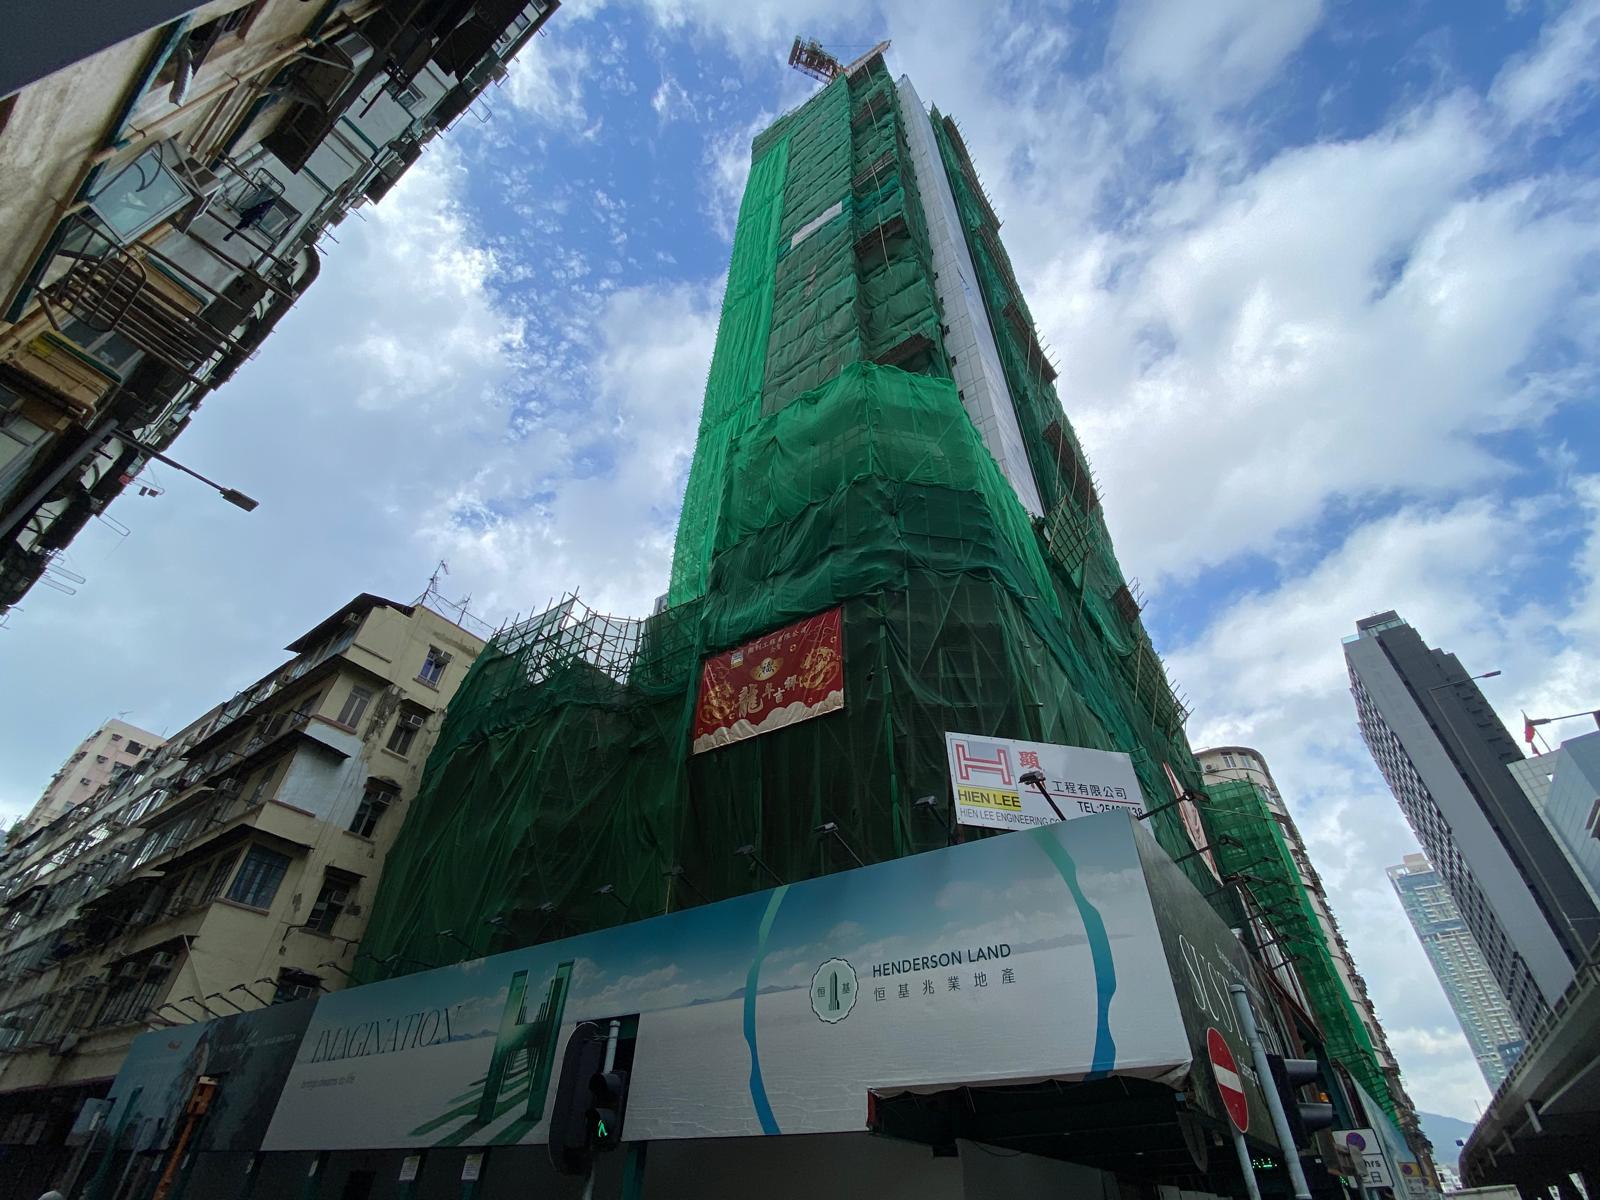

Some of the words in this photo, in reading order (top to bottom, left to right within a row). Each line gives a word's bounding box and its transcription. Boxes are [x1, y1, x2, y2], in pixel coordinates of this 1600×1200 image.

[735, 675, 797, 718] 龍年吉祥
[958, 789, 990, 804] HIEN
[992, 794, 1022, 808] LEE
[1052, 780, 1127, 800] 工程有限公司
[960, 807, 979, 818] HIEN
[980, 811, 995, 821] LEE
[996, 812, 1048, 826] ENGINEERING
[872, 950, 963, 978] HENDERSON
[967, 943, 1011, 963] LAND
[873, 968, 1015, 1002] 恒基兆業地產
[310, 1005, 464, 1063] IMAGINATION
